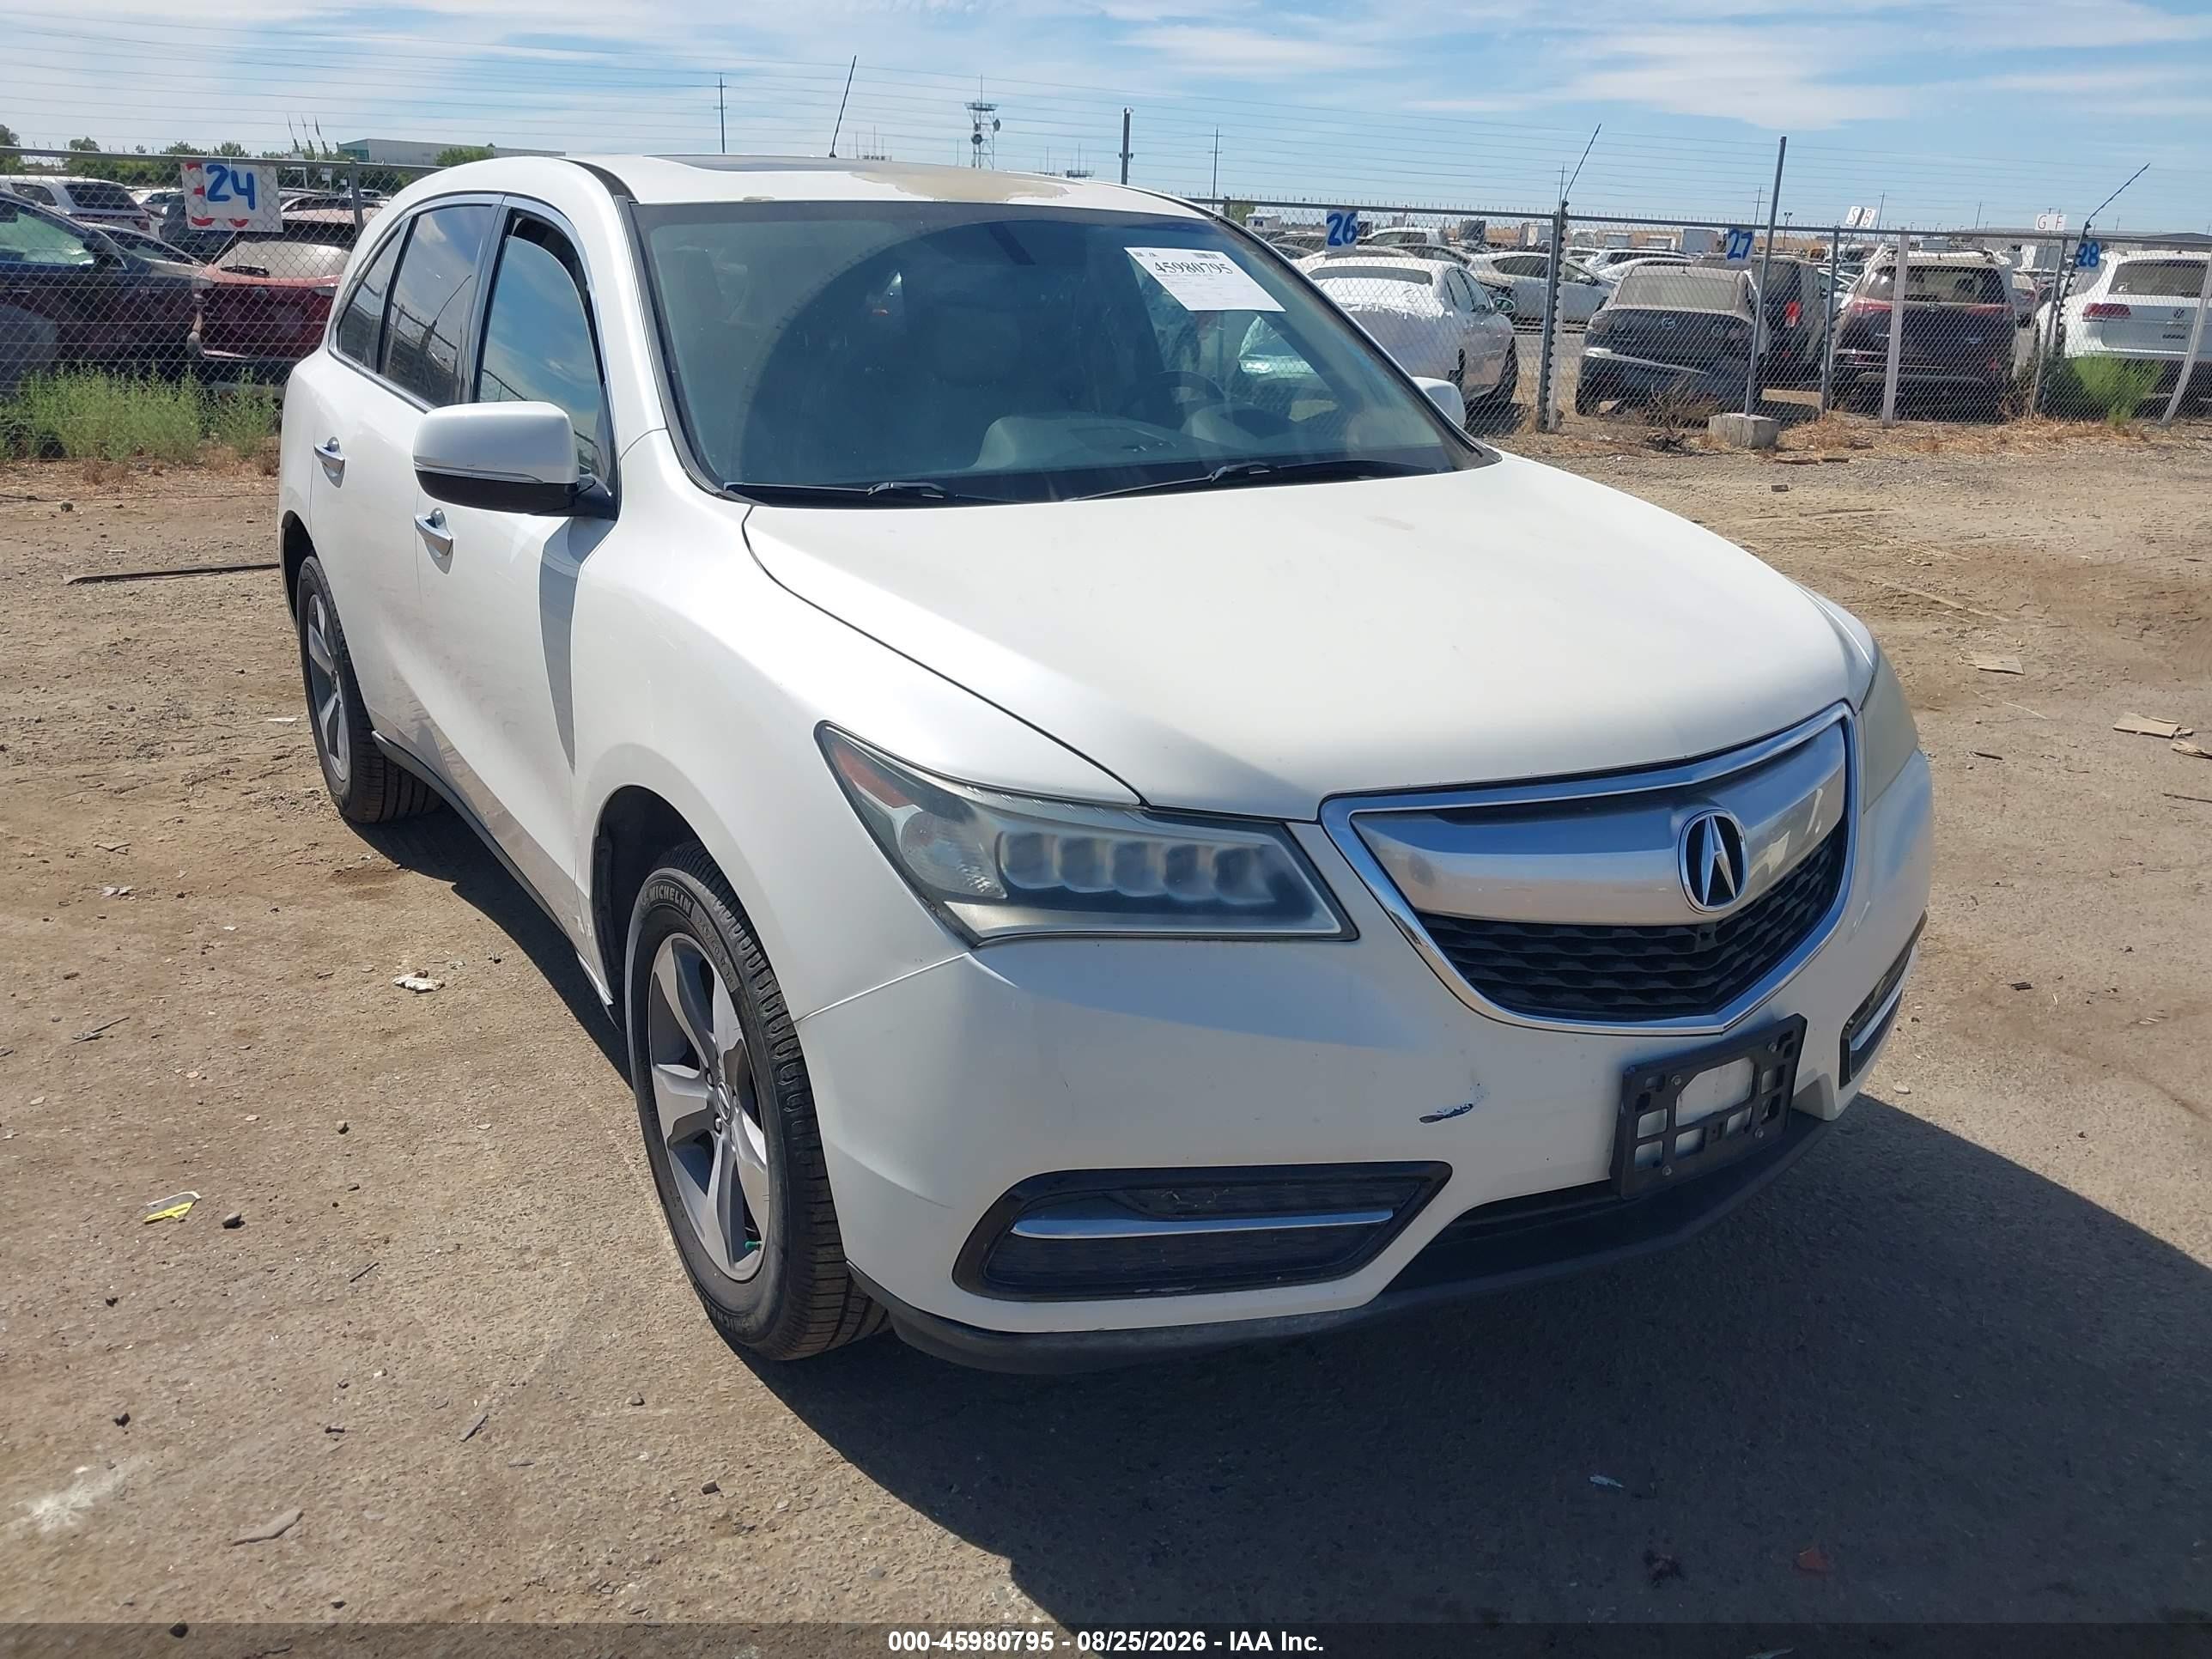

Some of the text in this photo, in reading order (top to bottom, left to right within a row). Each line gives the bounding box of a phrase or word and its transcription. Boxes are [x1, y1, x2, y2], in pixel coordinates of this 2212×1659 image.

[206, 165, 256, 210] 24
[1327, 212, 1358, 246] 26
[1849, 207, 1873, 226] S B
[2037, 215, 2063, 230] G F
[1727, 228, 1753, 260] 27
[2078, 241, 2100, 268] 28
[1154, 260, 1234, 275] 45980795
[648, 884, 691, 915] MICHELIN
